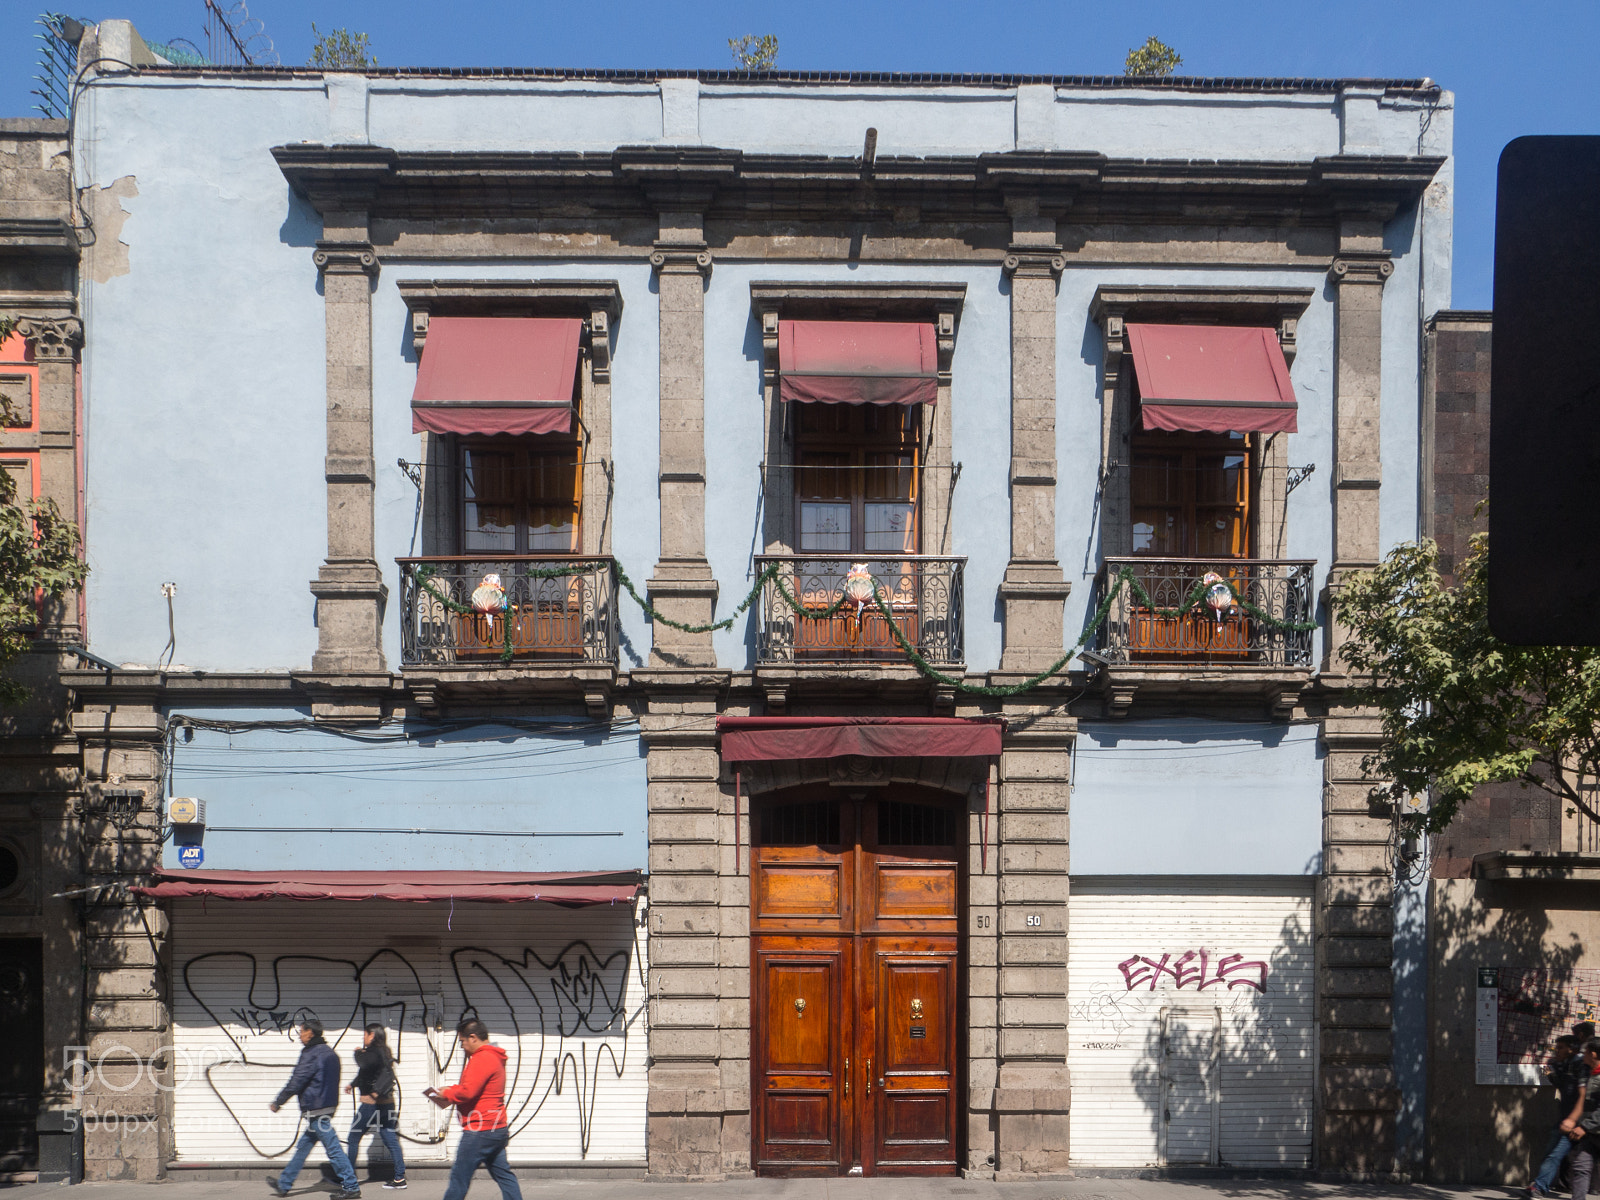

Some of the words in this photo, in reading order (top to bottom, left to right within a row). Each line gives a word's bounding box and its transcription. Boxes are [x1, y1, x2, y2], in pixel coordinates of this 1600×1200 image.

[182, 848, 200, 858] ADT
[977, 915, 991, 929] 50
[1027, 915, 1041, 927] 50
